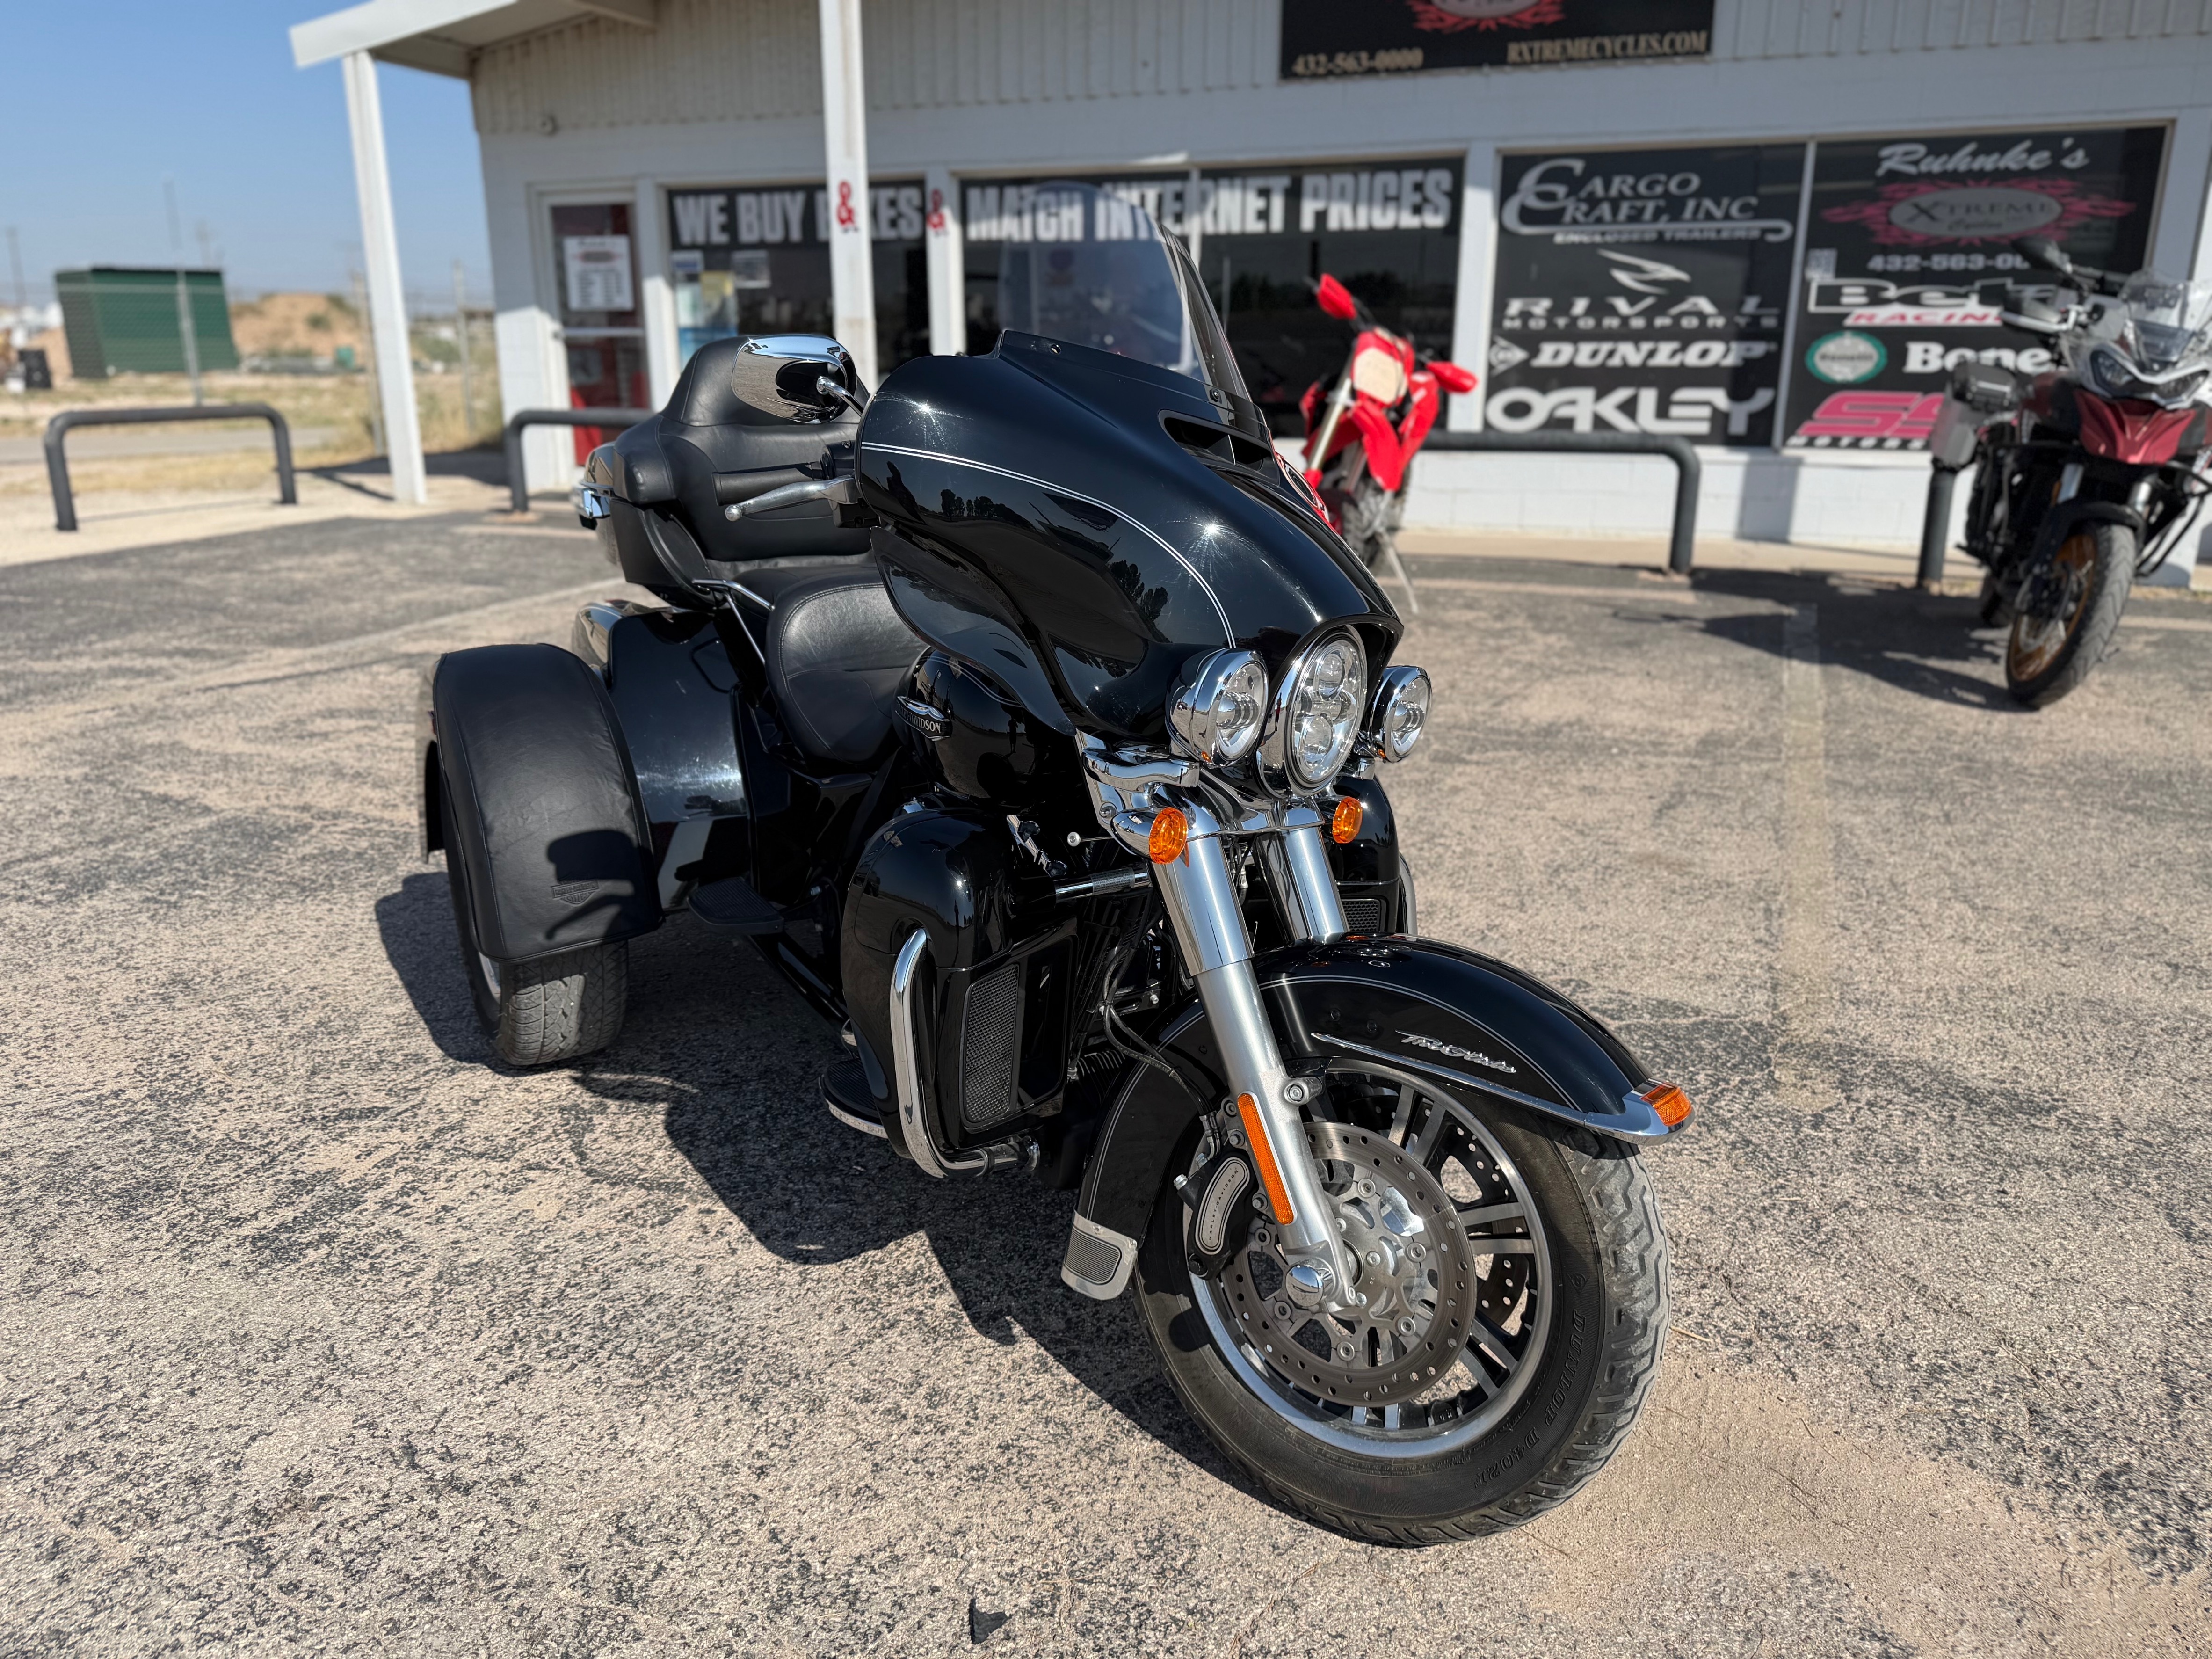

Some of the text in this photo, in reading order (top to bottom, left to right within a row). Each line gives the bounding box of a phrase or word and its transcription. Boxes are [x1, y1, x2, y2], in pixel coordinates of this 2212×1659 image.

[1292, 48, 1424, 75] 432-563-0000
[1876, 137, 2089, 177] Ruhnke's
[1517, 158, 1701, 209] CARGO
[674, 187, 925, 246] WE BUY BES
[966, 186, 1083, 241] MATCH
[1300, 169, 1452, 232] PRICES
[1683, 197, 1759, 221] INC
[1905, 200, 2052, 223] XTREME
[1867, 254, 2031, 271] 432-563-00
[1505, 296, 1779, 316] RIVAL
[1850, 312, 2002, 324] RACIN
[1502, 316, 1778, 330] MOTORSPORTS
[1530, 341, 1770, 367] DUNLOP
[1902, 341, 2053, 374] Bone
[1485, 386, 1776, 436] OAKLEY
[1209, 1169, 1239, 1240] HARLEY-DAVIDSON
[1545, 1310, 1586, 1427] DUNLOP
